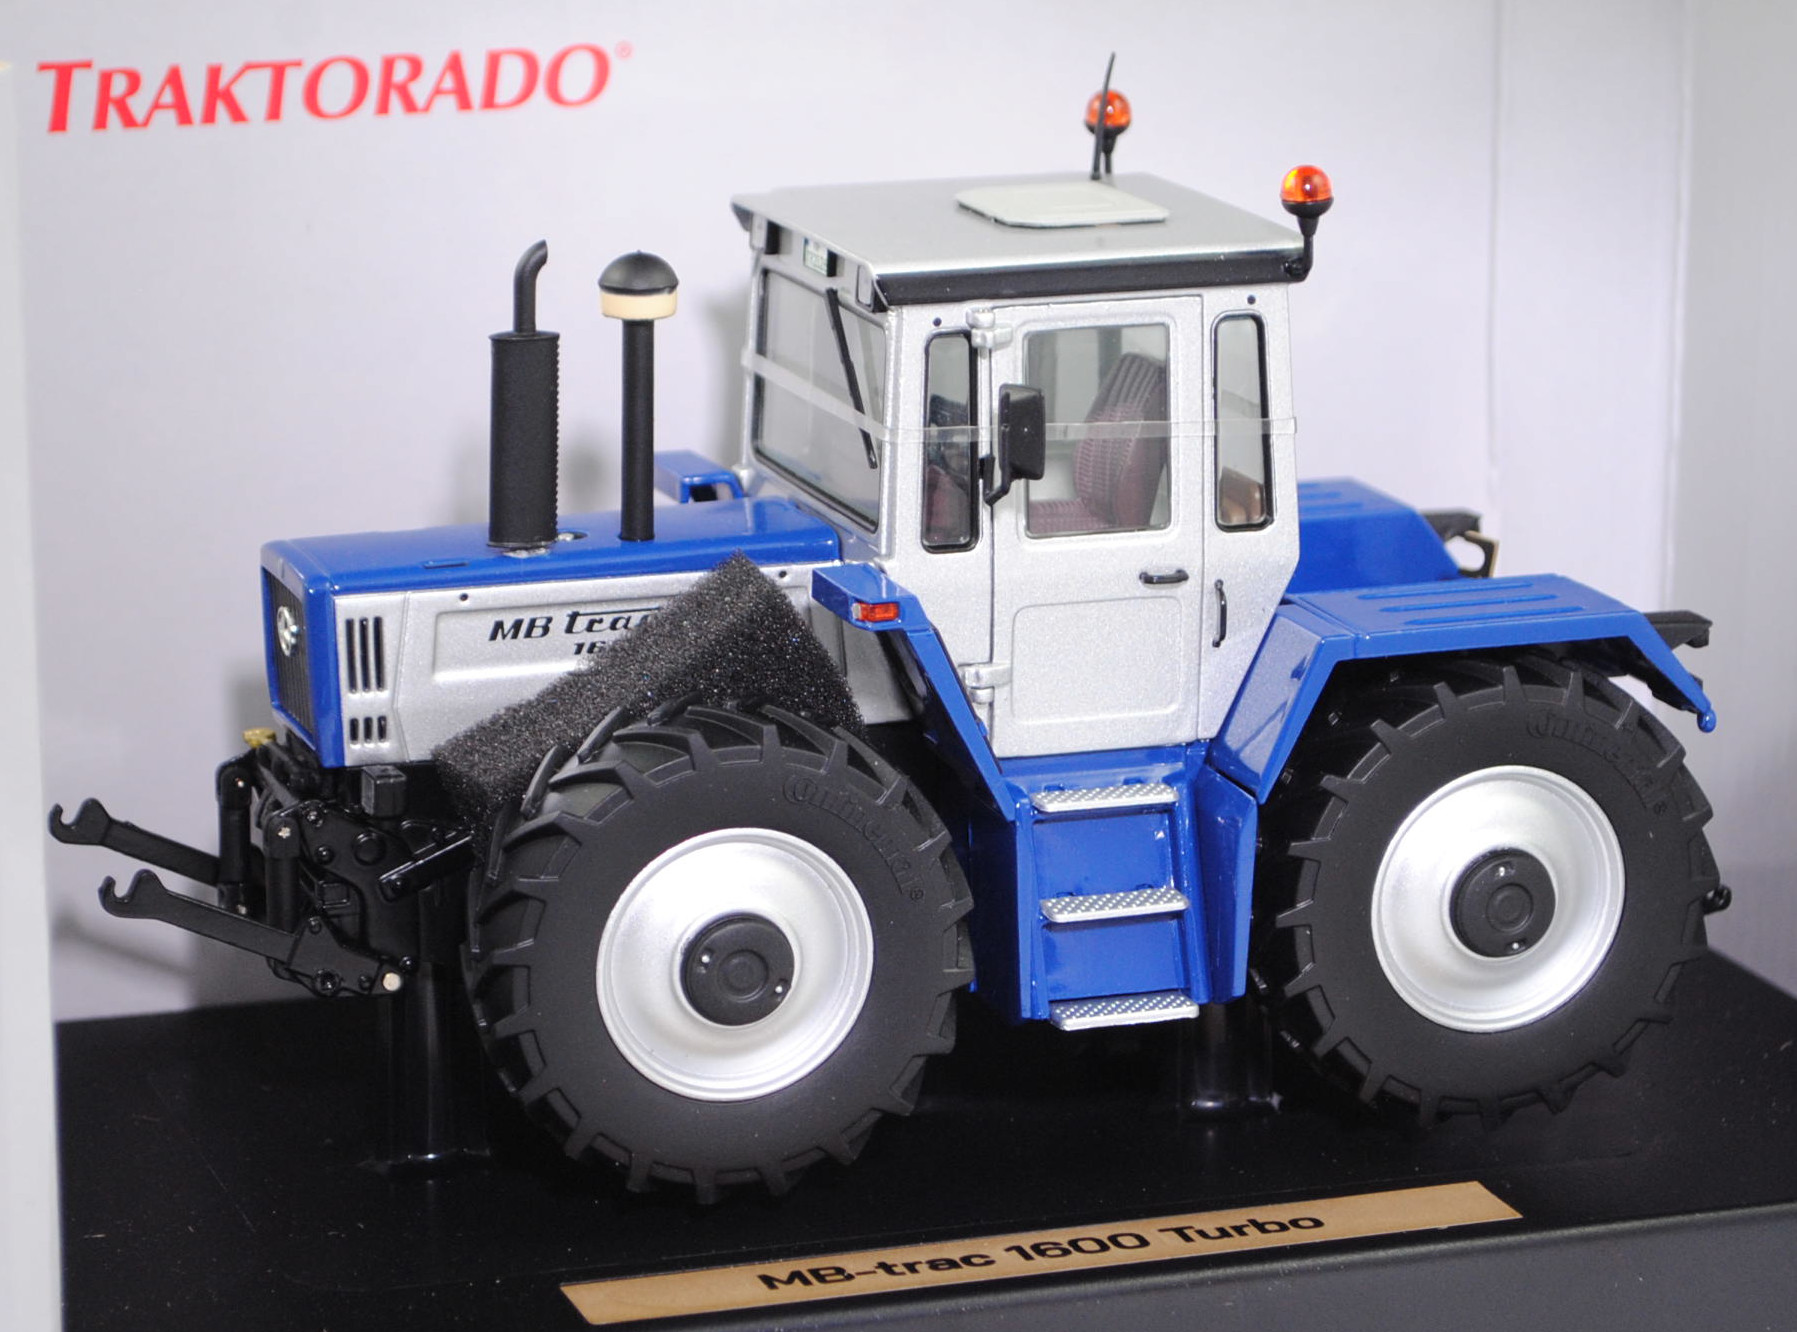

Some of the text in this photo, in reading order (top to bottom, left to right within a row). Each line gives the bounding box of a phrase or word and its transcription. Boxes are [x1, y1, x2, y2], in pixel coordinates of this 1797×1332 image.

[488, 616, 553, 642] MB
[757, 1216, 1325, 1290] MB-trac 1600 Turbo
